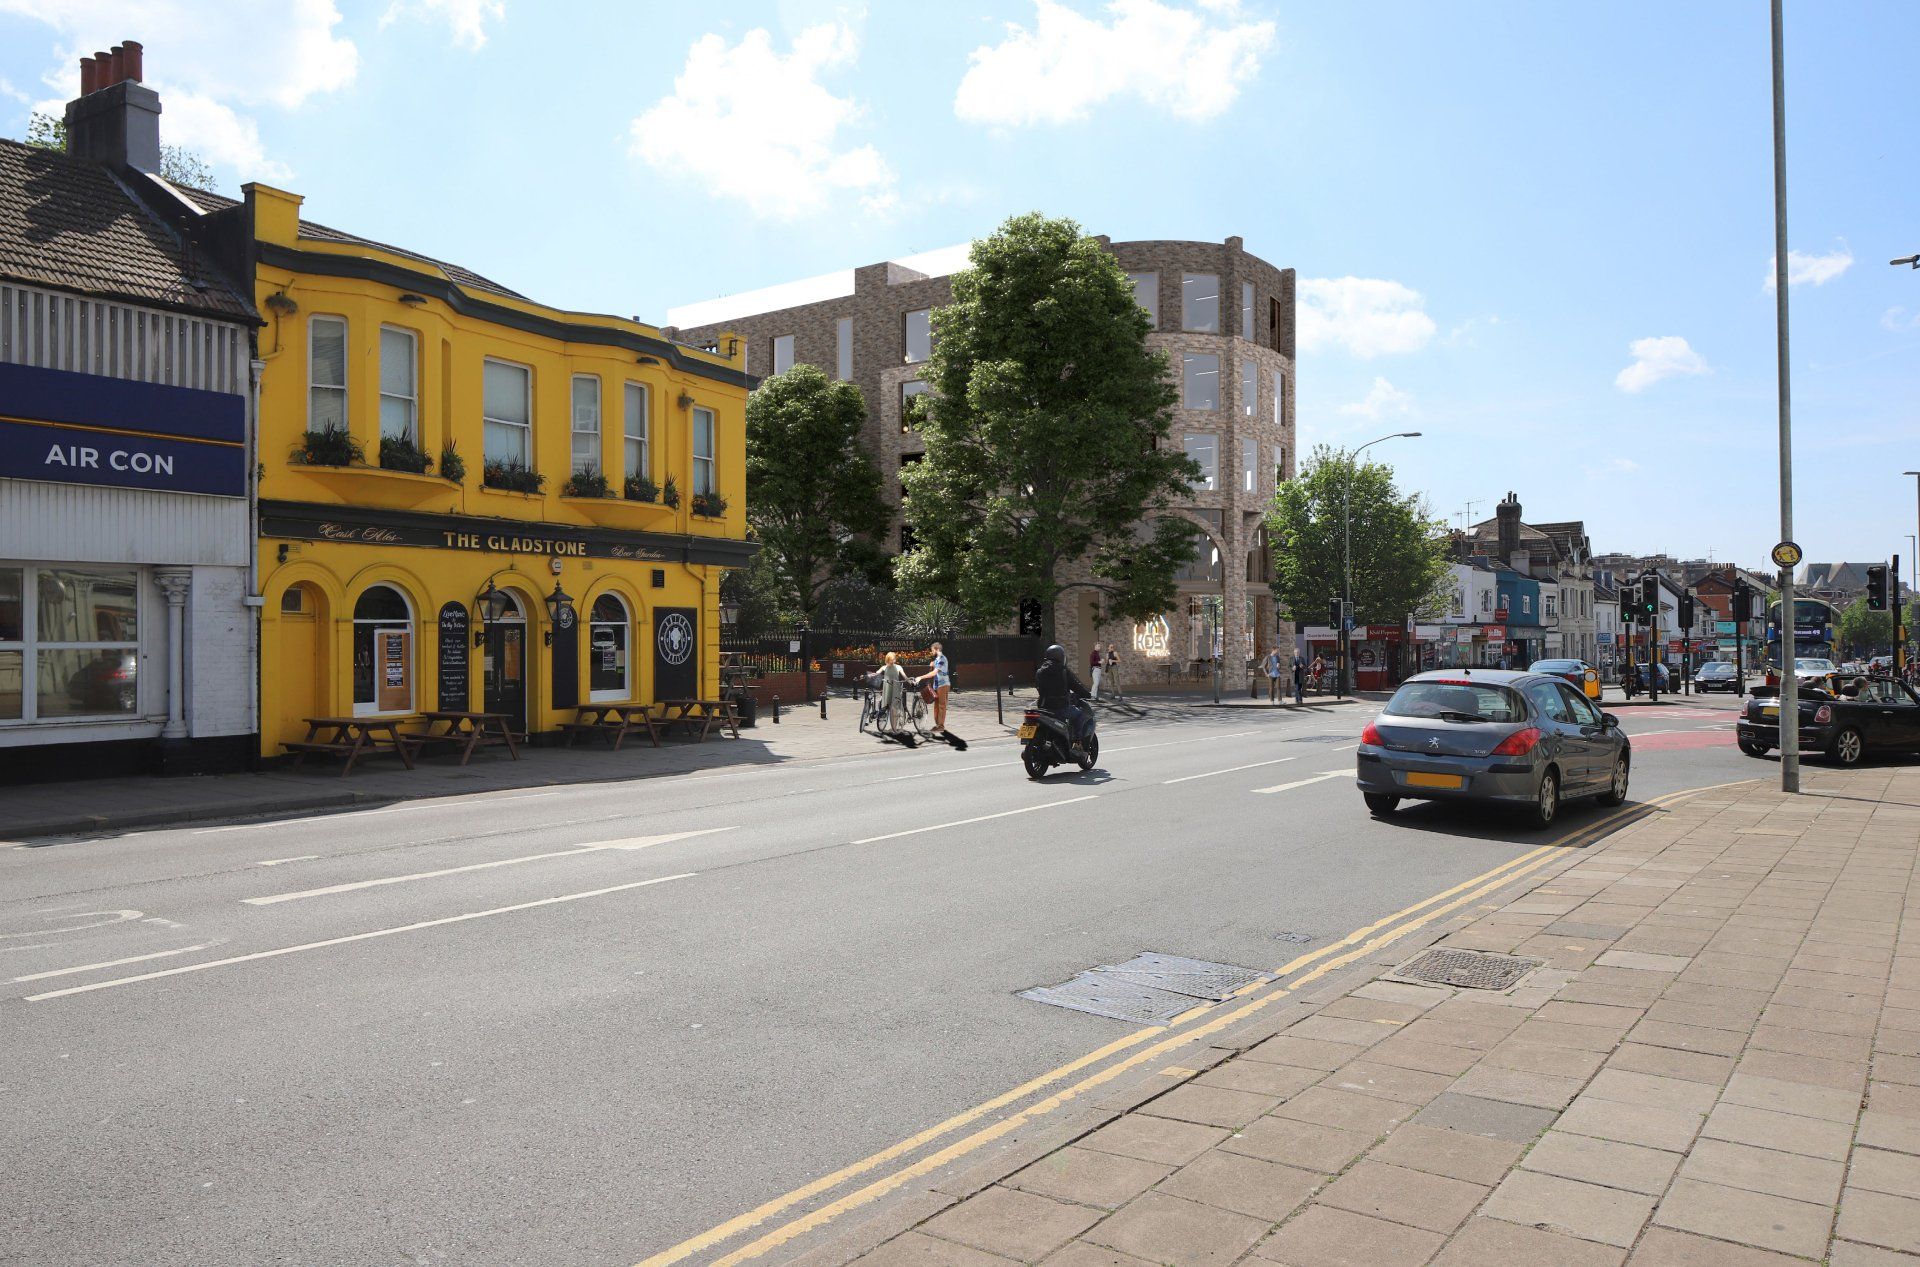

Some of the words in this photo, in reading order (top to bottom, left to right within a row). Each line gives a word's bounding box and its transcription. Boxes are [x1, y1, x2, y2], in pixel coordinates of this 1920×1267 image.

[45, 444, 99, 469] AIR
[109, 450, 173, 475] CON
[318, 523, 360, 539] Cask
[362, 527, 403, 542] Ales
[443, 532, 480, 549] THE
[487, 536, 586, 556] GLADSTONE
[611, 544, 634, 558] Beer
[635, 548, 666, 560] Garden
